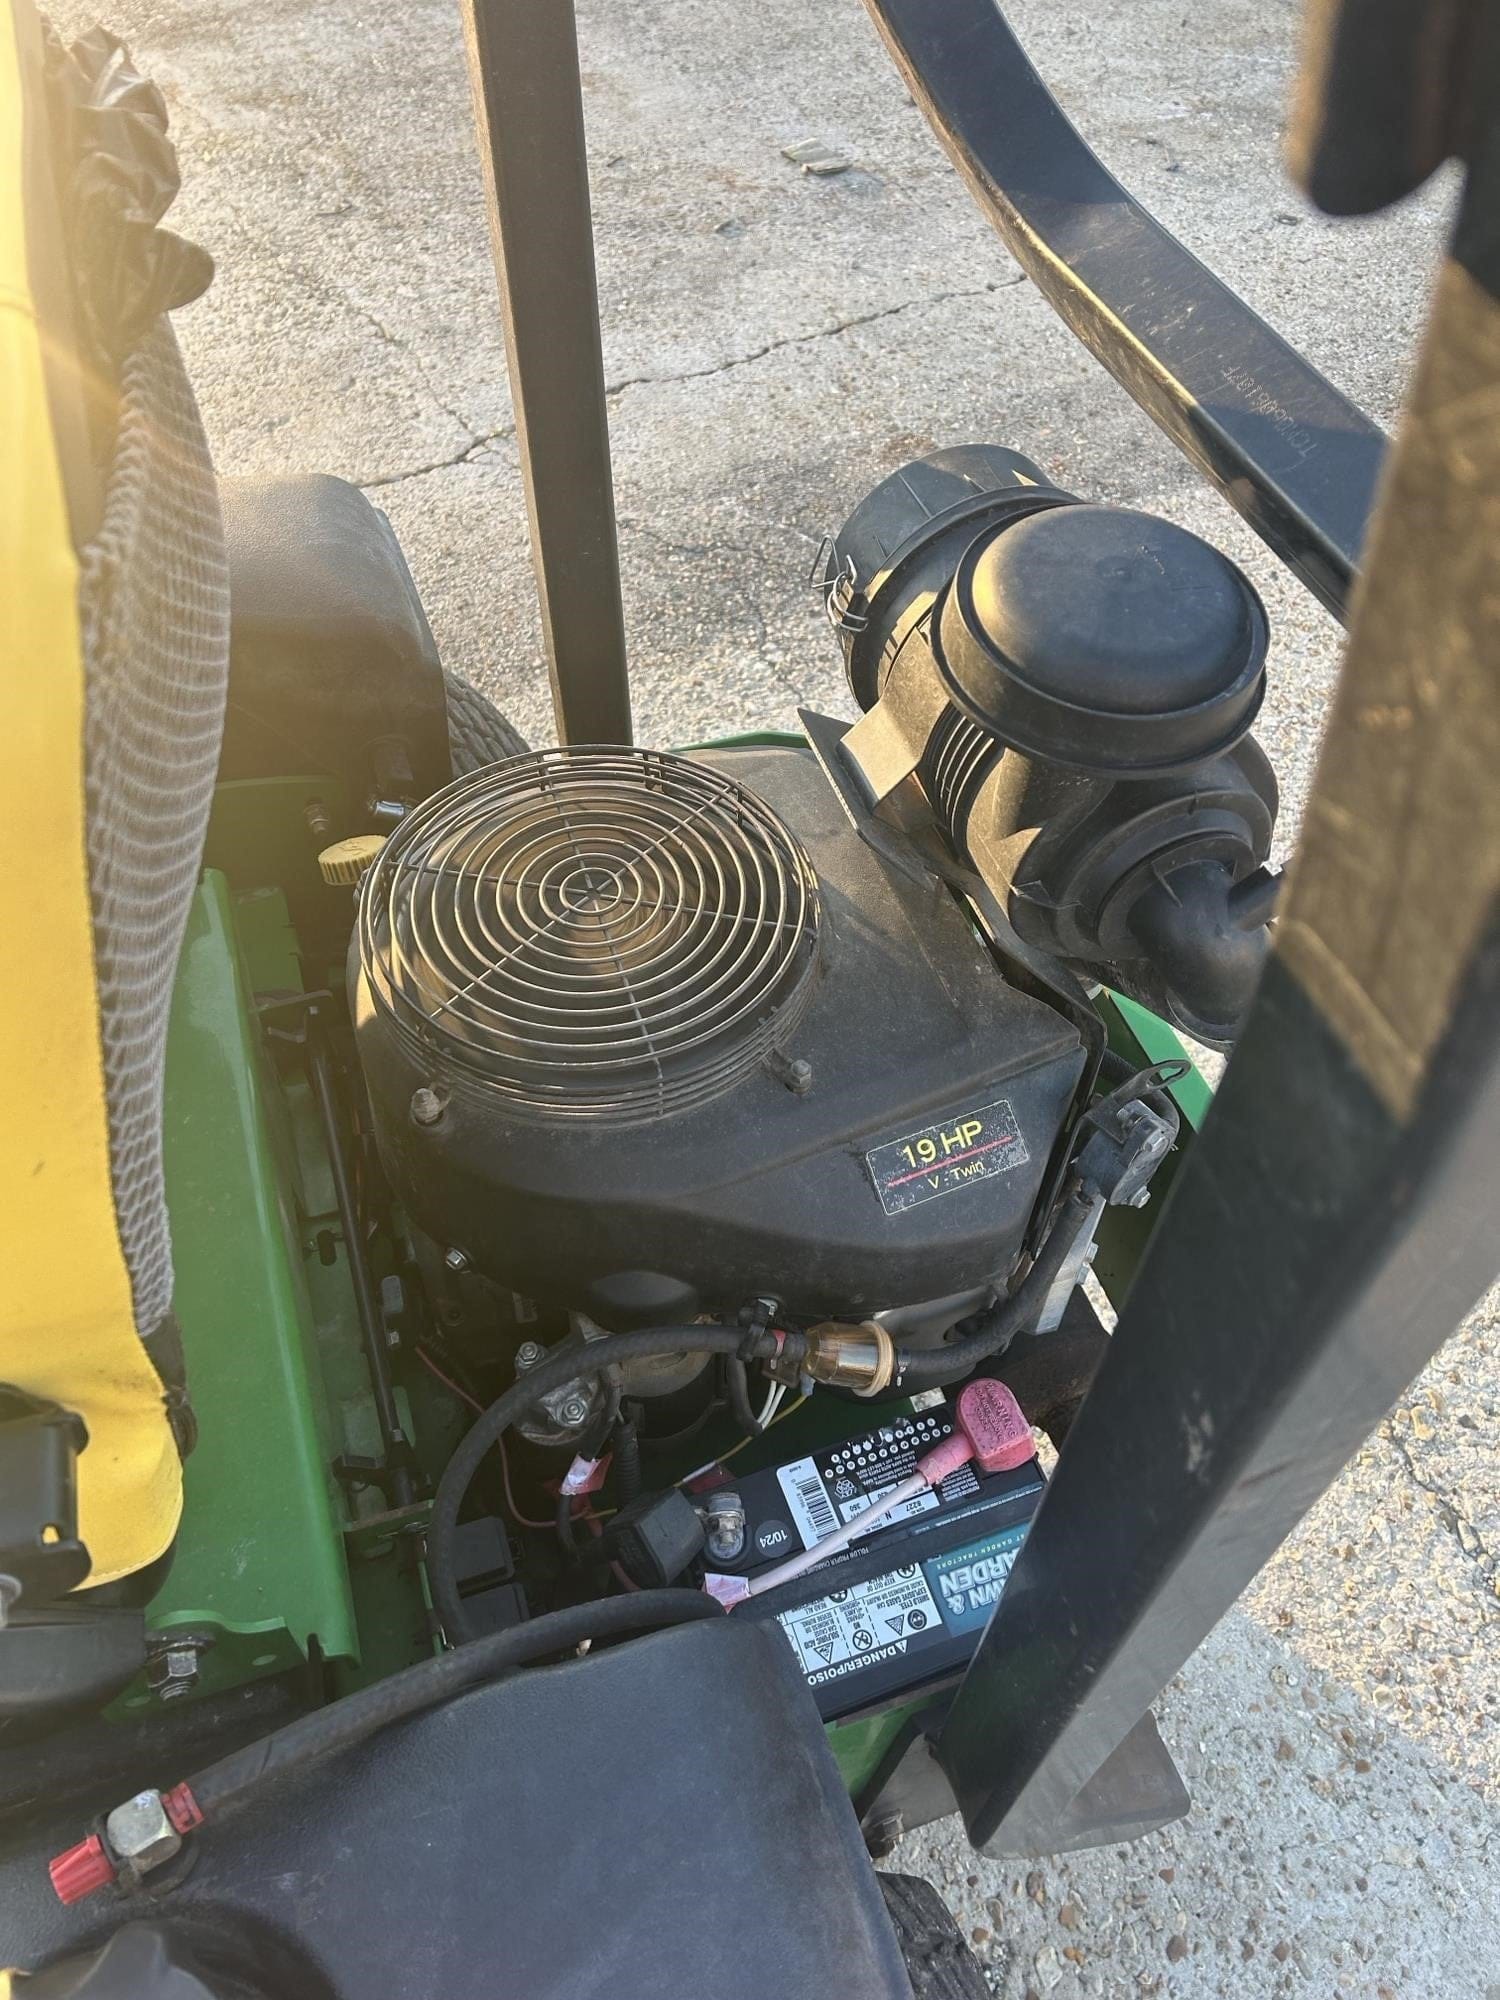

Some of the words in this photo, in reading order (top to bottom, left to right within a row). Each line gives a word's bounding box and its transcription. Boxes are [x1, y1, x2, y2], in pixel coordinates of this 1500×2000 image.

[902, 1138, 937, 1168] 19
[939, 1120, 984, 1155] HP
[928, 1176, 940, 1190] V
[951, 1160, 984, 1181] Twin
[984, 1381, 1017, 1437] WARNING
[904, 1499, 922, 1511] 8227
[758, 1528, 788, 1548] 10/24
[938, 1546, 1019, 1597] ARDEN
[806, 1644, 897, 1685] DANGER/POISO
